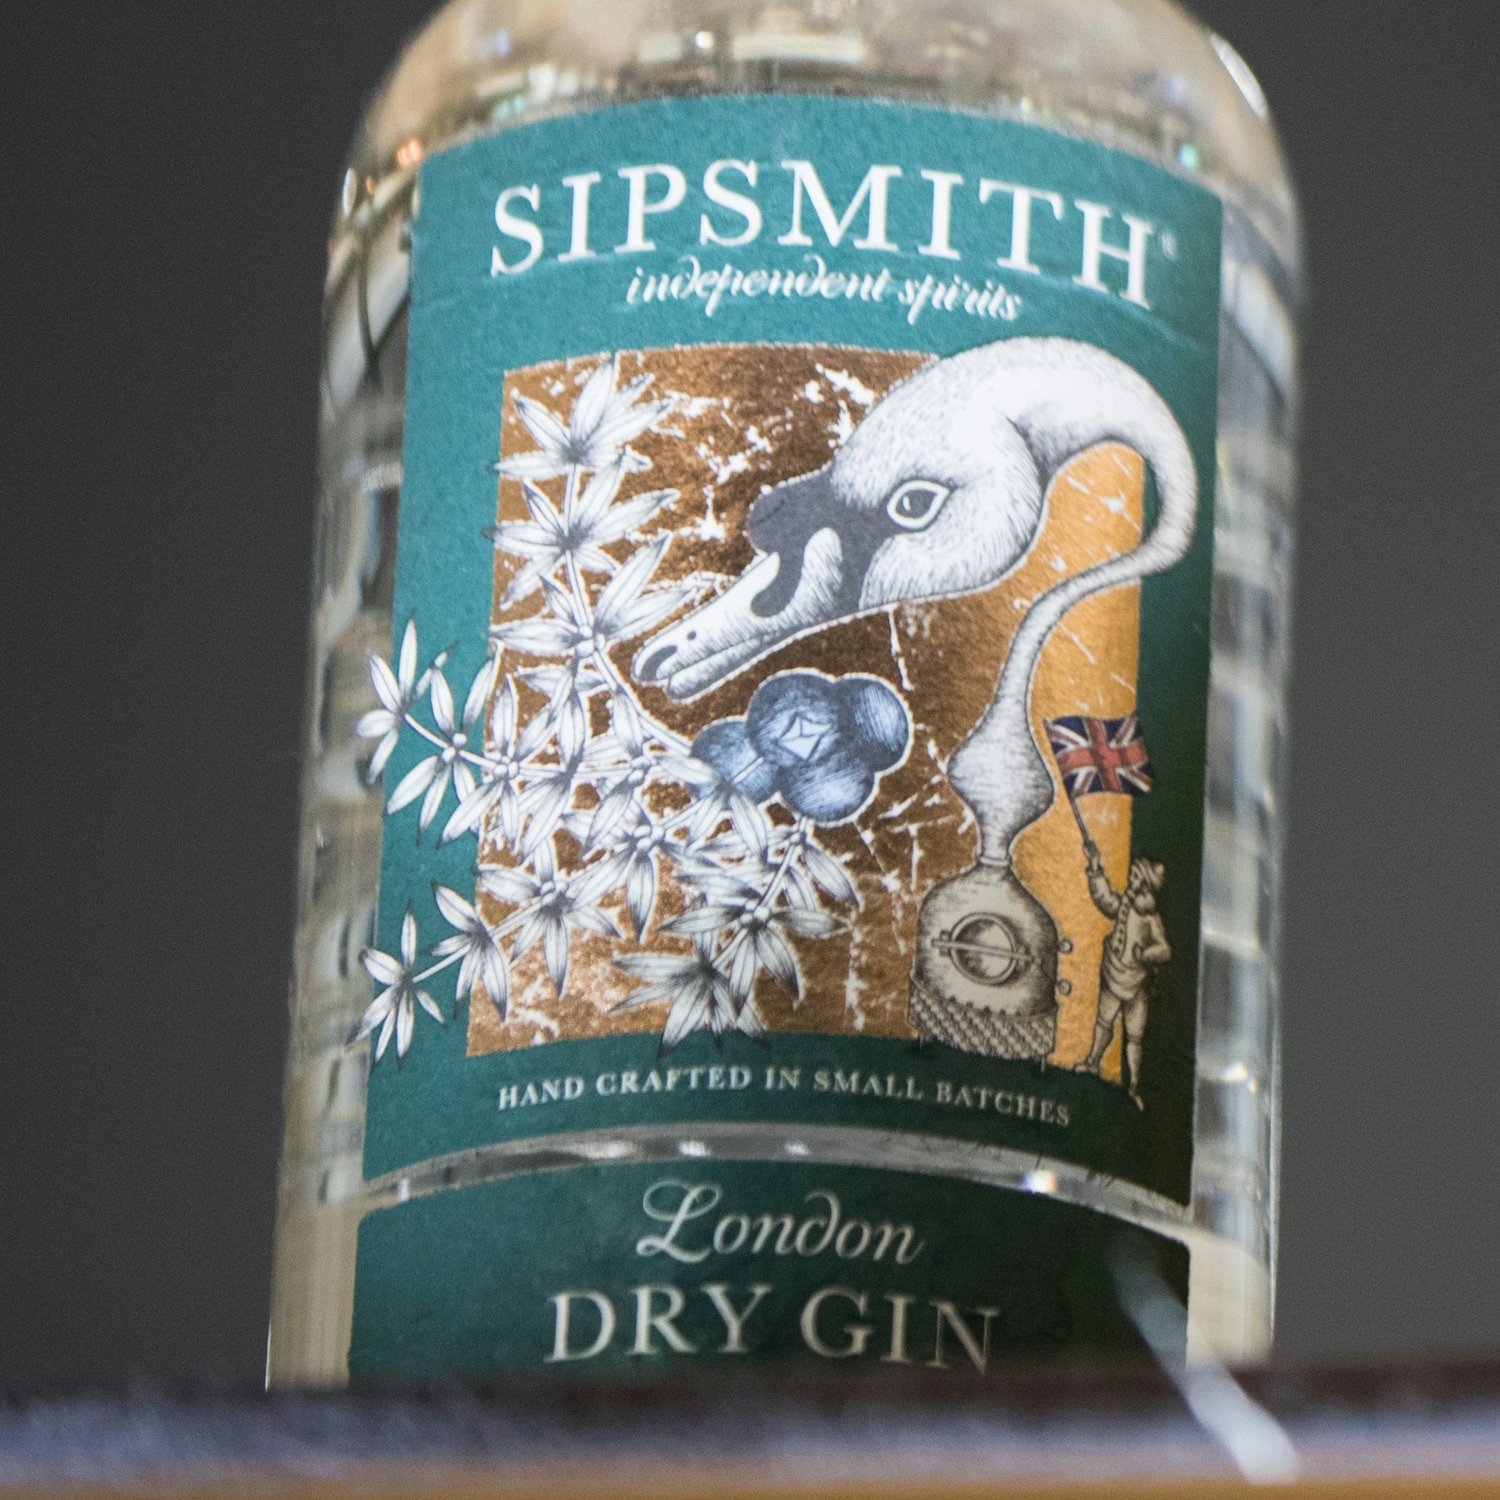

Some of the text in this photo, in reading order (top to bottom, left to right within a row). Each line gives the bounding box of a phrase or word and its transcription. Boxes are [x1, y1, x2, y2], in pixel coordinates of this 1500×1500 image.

[626, 256, 1021, 324] independent spirits
[497, 1065, 1071, 1128] HAND CRAFTED IN SMALL BATCHES
[635, 1179, 925, 1265] London
[544, 1282, 999, 1377] DRY GIN
